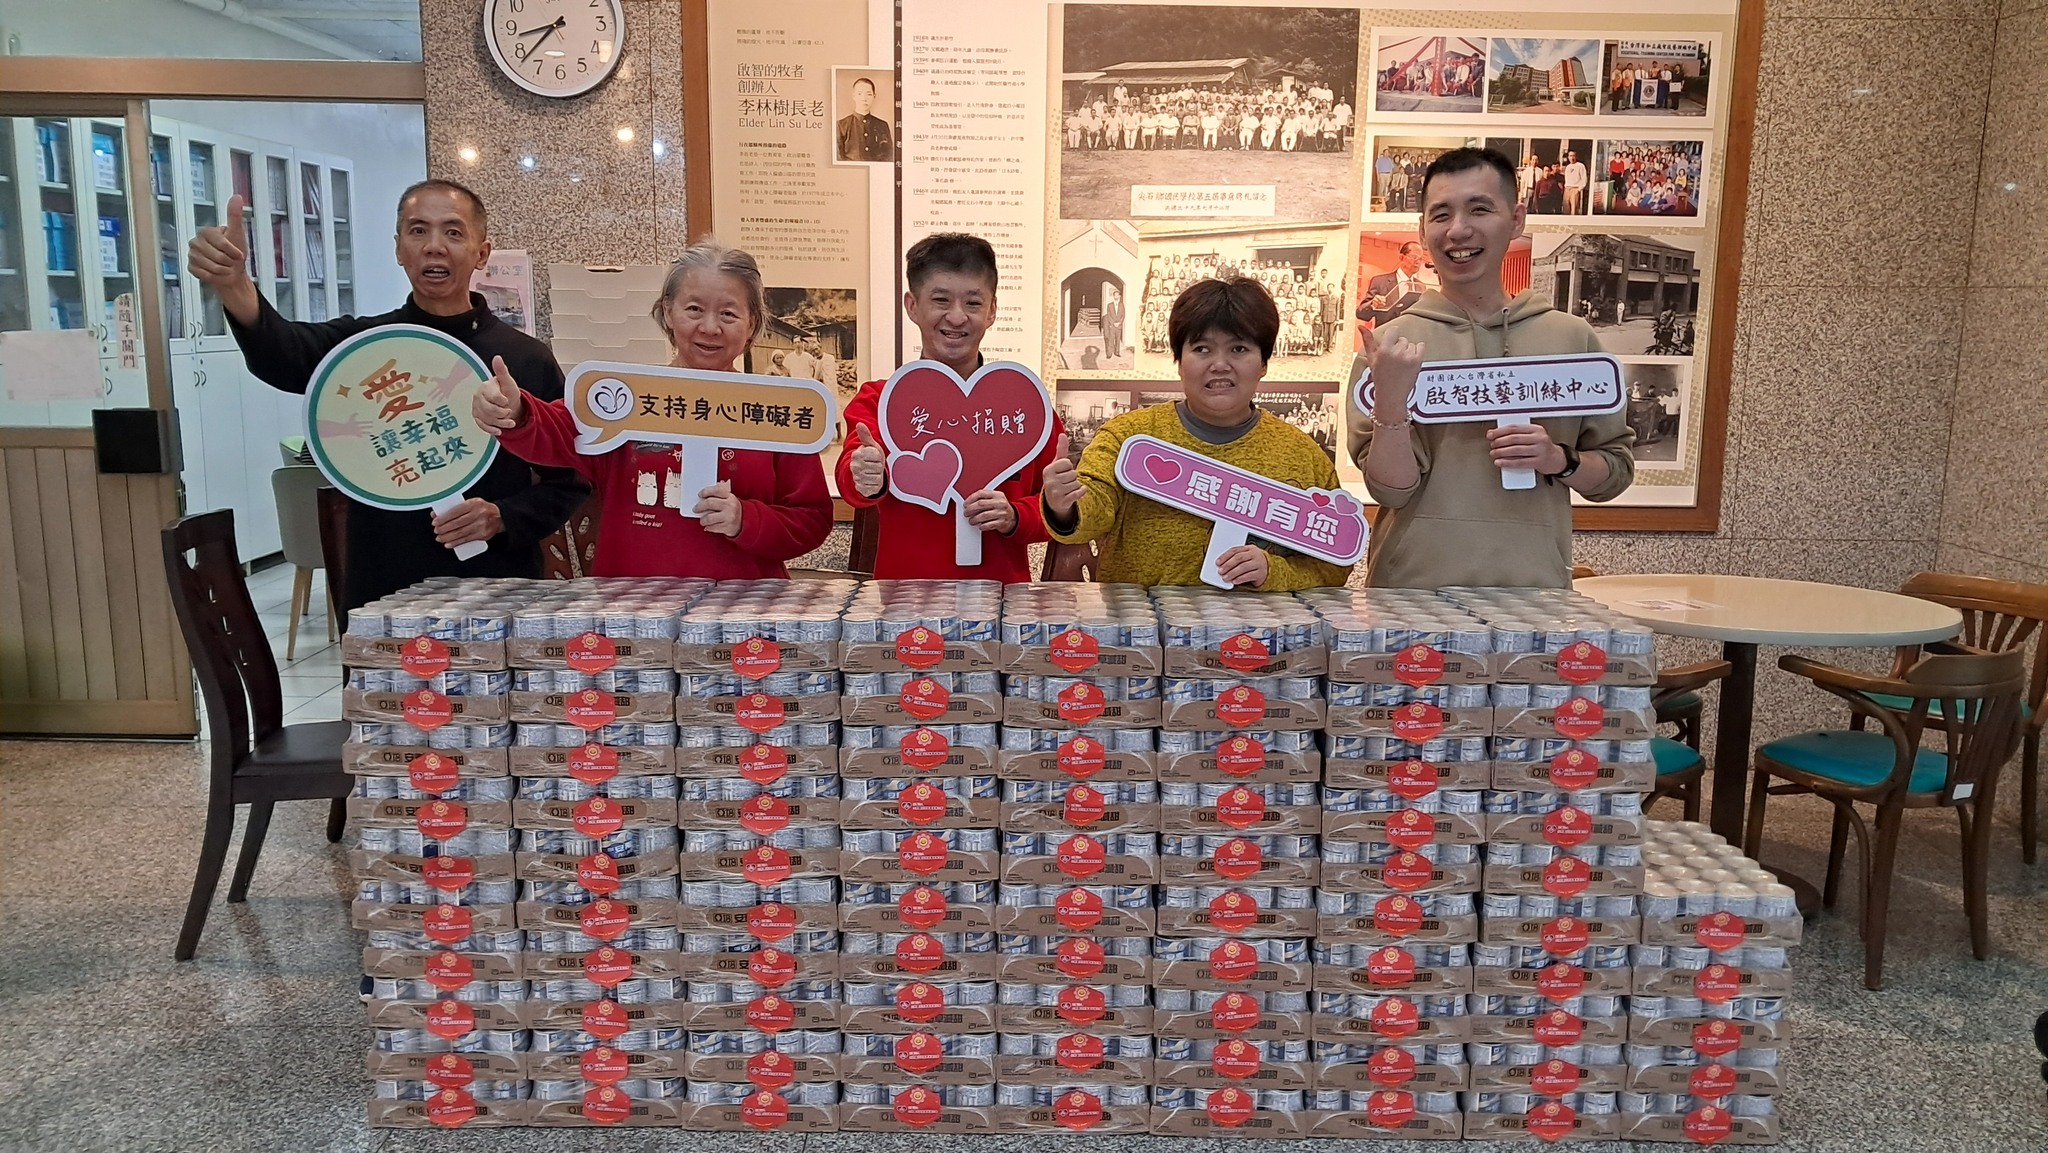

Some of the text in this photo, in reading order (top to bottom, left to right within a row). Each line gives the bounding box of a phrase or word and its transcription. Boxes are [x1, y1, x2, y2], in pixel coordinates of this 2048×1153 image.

[505, 19, 517, 36] 9
[595, 15, 607, 32] 3
[514, 42, 526, 59] 8
[590, 39, 601, 55] 4
[532, 59, 543, 75] 7
[554, 64, 567, 80] 6
[577, 57, 588, 73] 5
[737, 63, 804, 78] 啟智的牧者
[737, 80, 777, 94] 創辦人
[738, 99, 824, 117] 李林樹長老
[739, 118, 823, 129] Elder Lin Su Lee
[118, 294, 136, 369] 請隨手關門
[1426, 370, 1516, 383] 財團法人台灣省私立
[359, 358, 425, 424] 愛
[1424, 377, 1609, 408] 啟智技藝訓練中心
[638, 393, 815, 430] 支持身心障礙者
[909, 405, 1026, 439] 愛心捐贈
[369, 404, 459, 458] 讓幸福
[385, 435, 474, 487] 亮起來
[1184, 470, 1339, 546] 感謝有您
